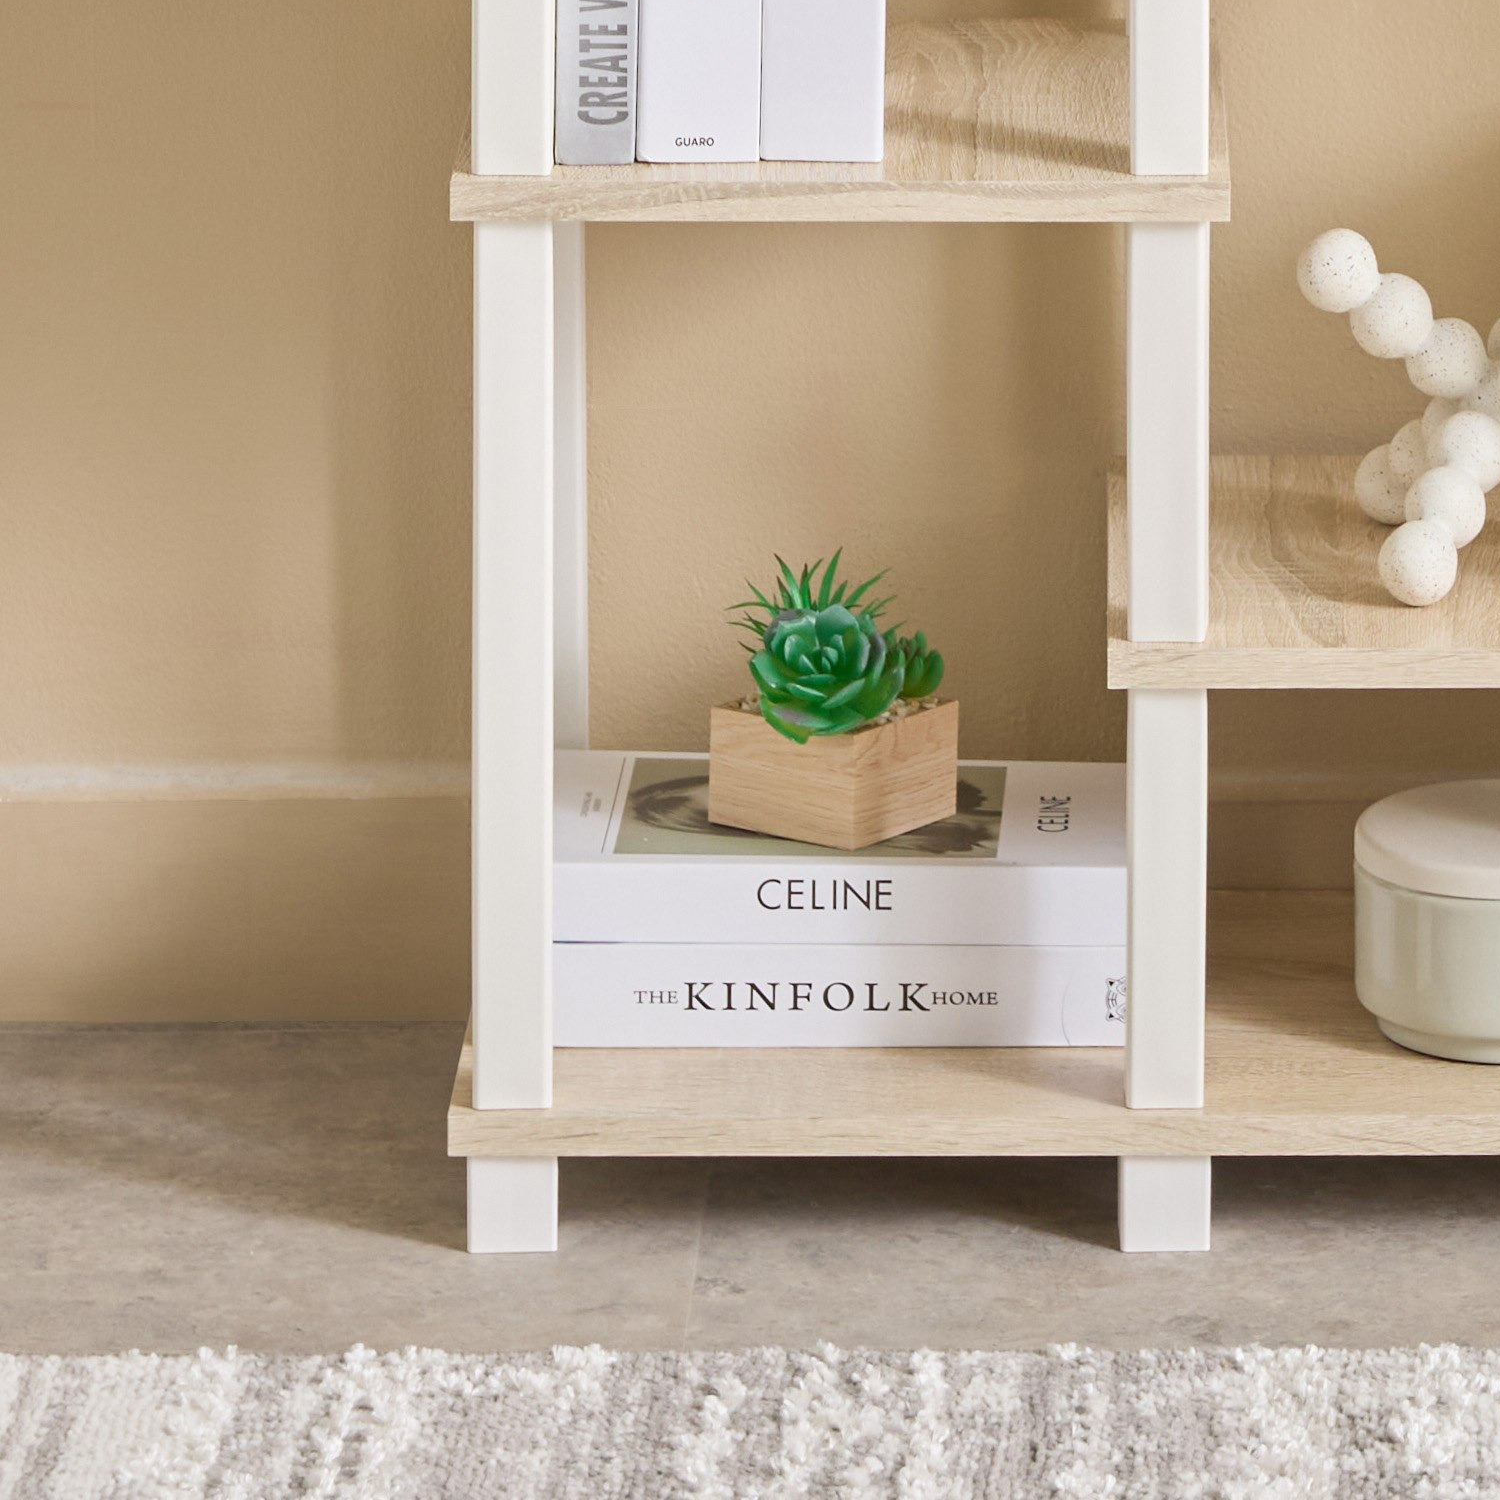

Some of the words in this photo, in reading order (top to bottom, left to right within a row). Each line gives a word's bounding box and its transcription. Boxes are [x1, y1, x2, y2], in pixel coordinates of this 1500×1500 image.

[577, 24, 629, 125] CREATE
[675, 137, 715, 146] GUARO
[1037, 796, 1071, 832] CELINE
[757, 879, 893, 911] CELINE
[634, 990, 678, 1004] THE
[684, 982, 931, 1011] KINFOLK
[932, 991, 999, 1005] HOME
